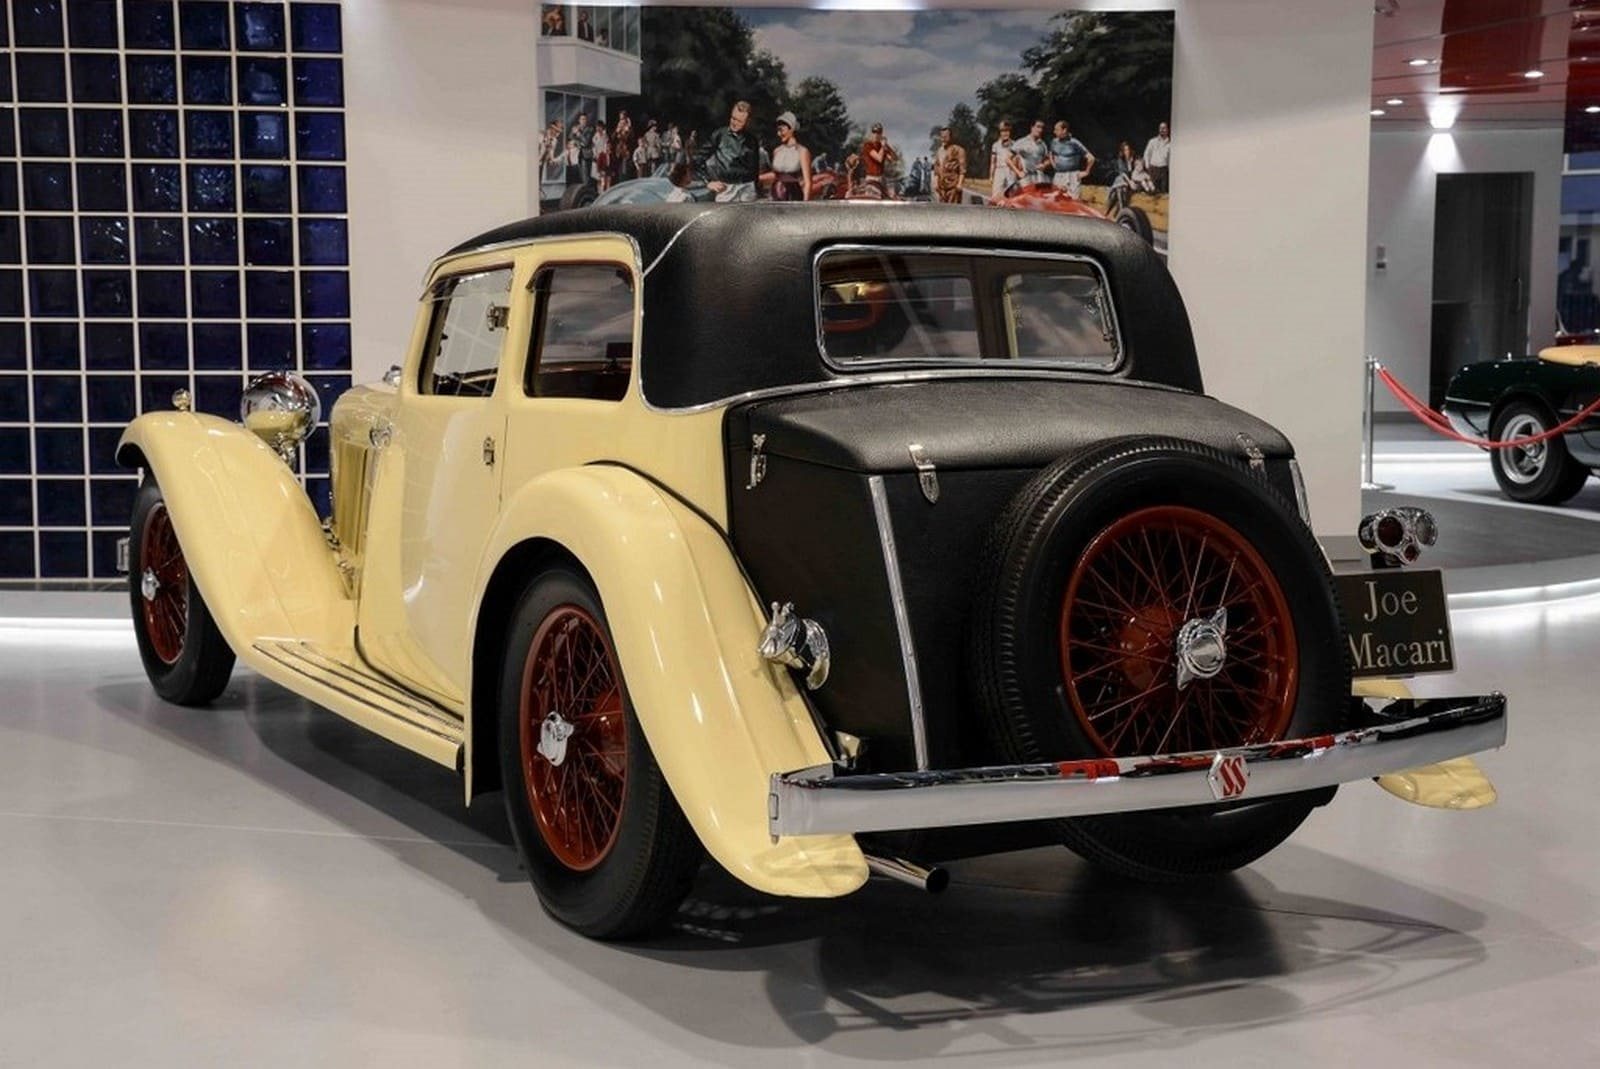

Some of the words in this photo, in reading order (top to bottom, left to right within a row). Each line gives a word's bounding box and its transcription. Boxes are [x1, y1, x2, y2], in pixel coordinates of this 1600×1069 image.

[1364, 581, 1418, 621] Joe
[1349, 629, 1448, 669] Macari
[1220, 756, 1246, 796] SS
